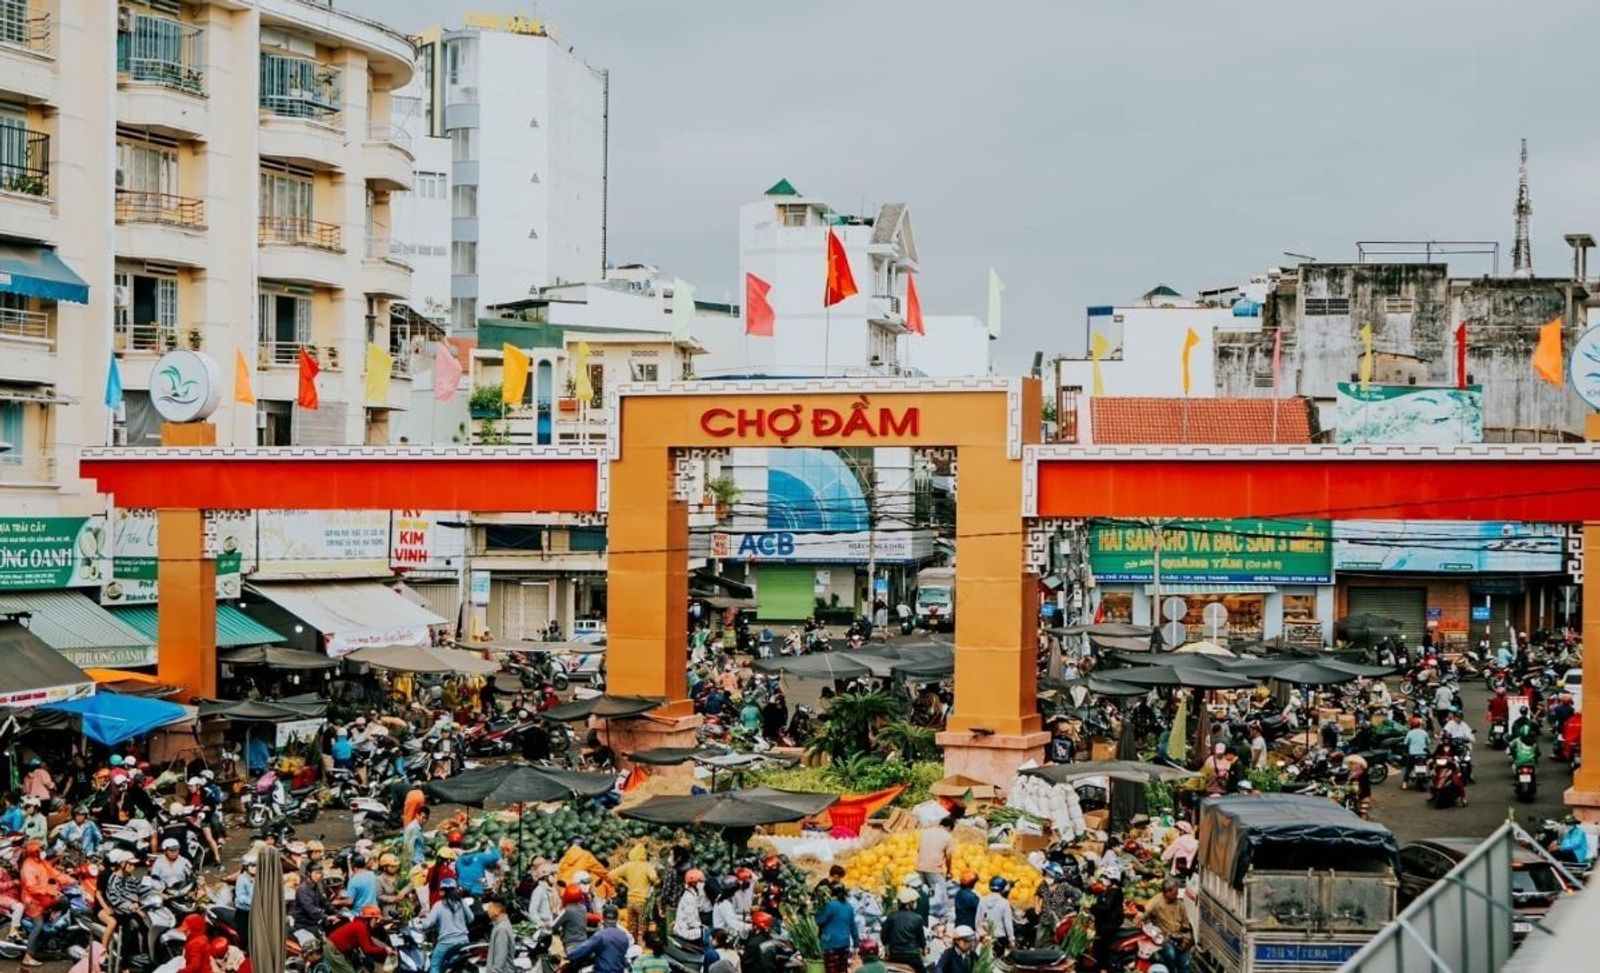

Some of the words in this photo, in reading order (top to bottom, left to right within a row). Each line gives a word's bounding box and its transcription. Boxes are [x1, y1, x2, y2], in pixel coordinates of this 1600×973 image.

[700, 404, 803, 444] CHỢ
[811, 395, 920, 437] ĐẦM
[400, 531, 424, 545] KIM
[738, 531, 794, 555] ACB
[30, 548, 72, 568] OANH
[395, 548, 428, 563] VINH
